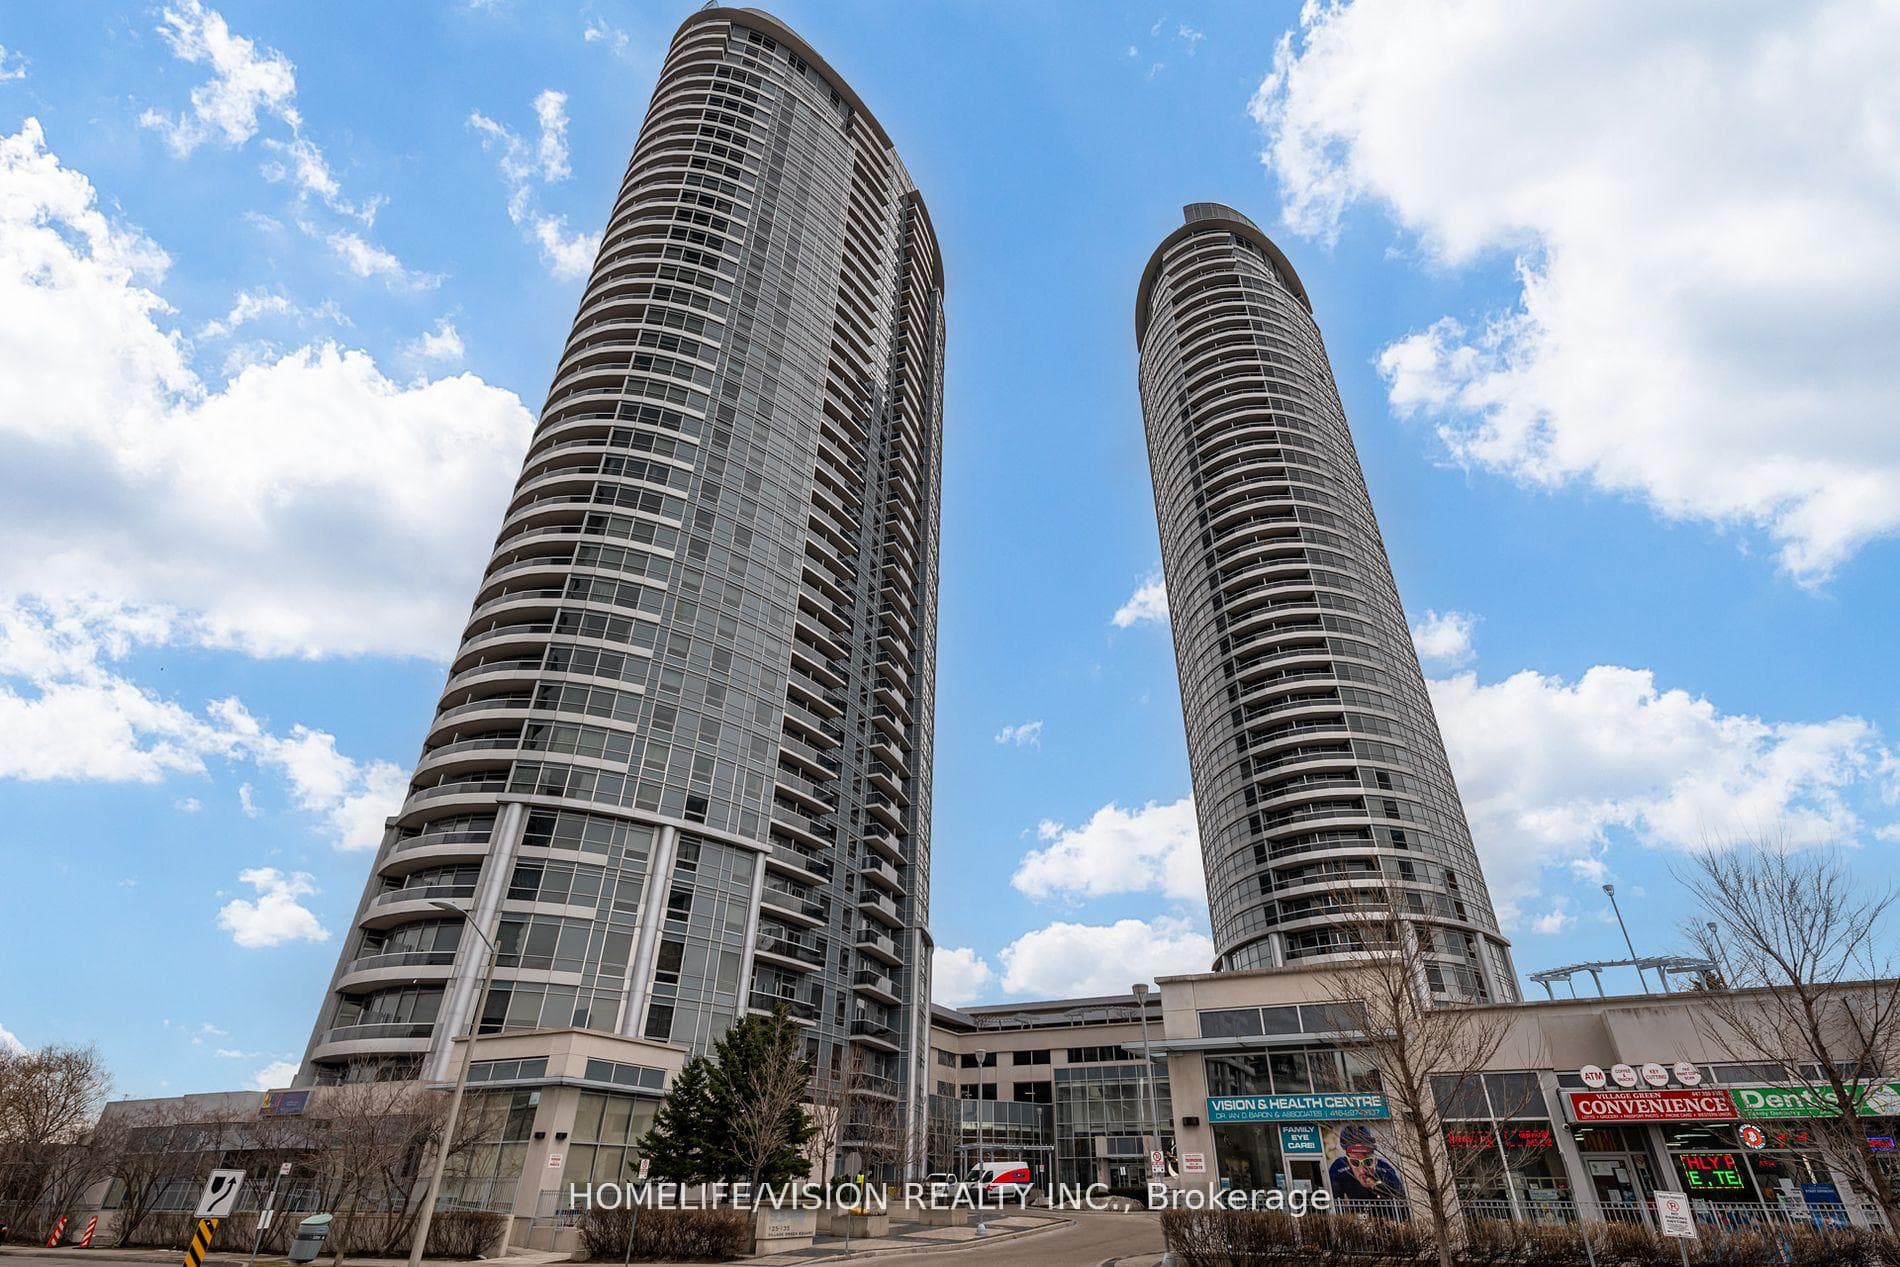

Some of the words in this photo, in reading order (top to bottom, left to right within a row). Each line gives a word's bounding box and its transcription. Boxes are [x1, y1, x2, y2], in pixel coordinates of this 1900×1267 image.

[1584, 1072, 1604, 1080] ATM
[1212, 1099, 1256, 1111] VISION
[1257, 1099, 1268, 1110] &
[1269, 1097, 1323, 1110] HEALTH
[1325, 1095, 1382, 1108] CENTRE
[1579, 1097, 1730, 1115] CONVENIENCE
[1739, 1088, 1850, 1109] Dentis
[1248, 1111, 1273, 1119] BARON
[1281, 1110, 1322, 1118] ASSOCIATES
[1689, 1171, 1703, 1185] E
